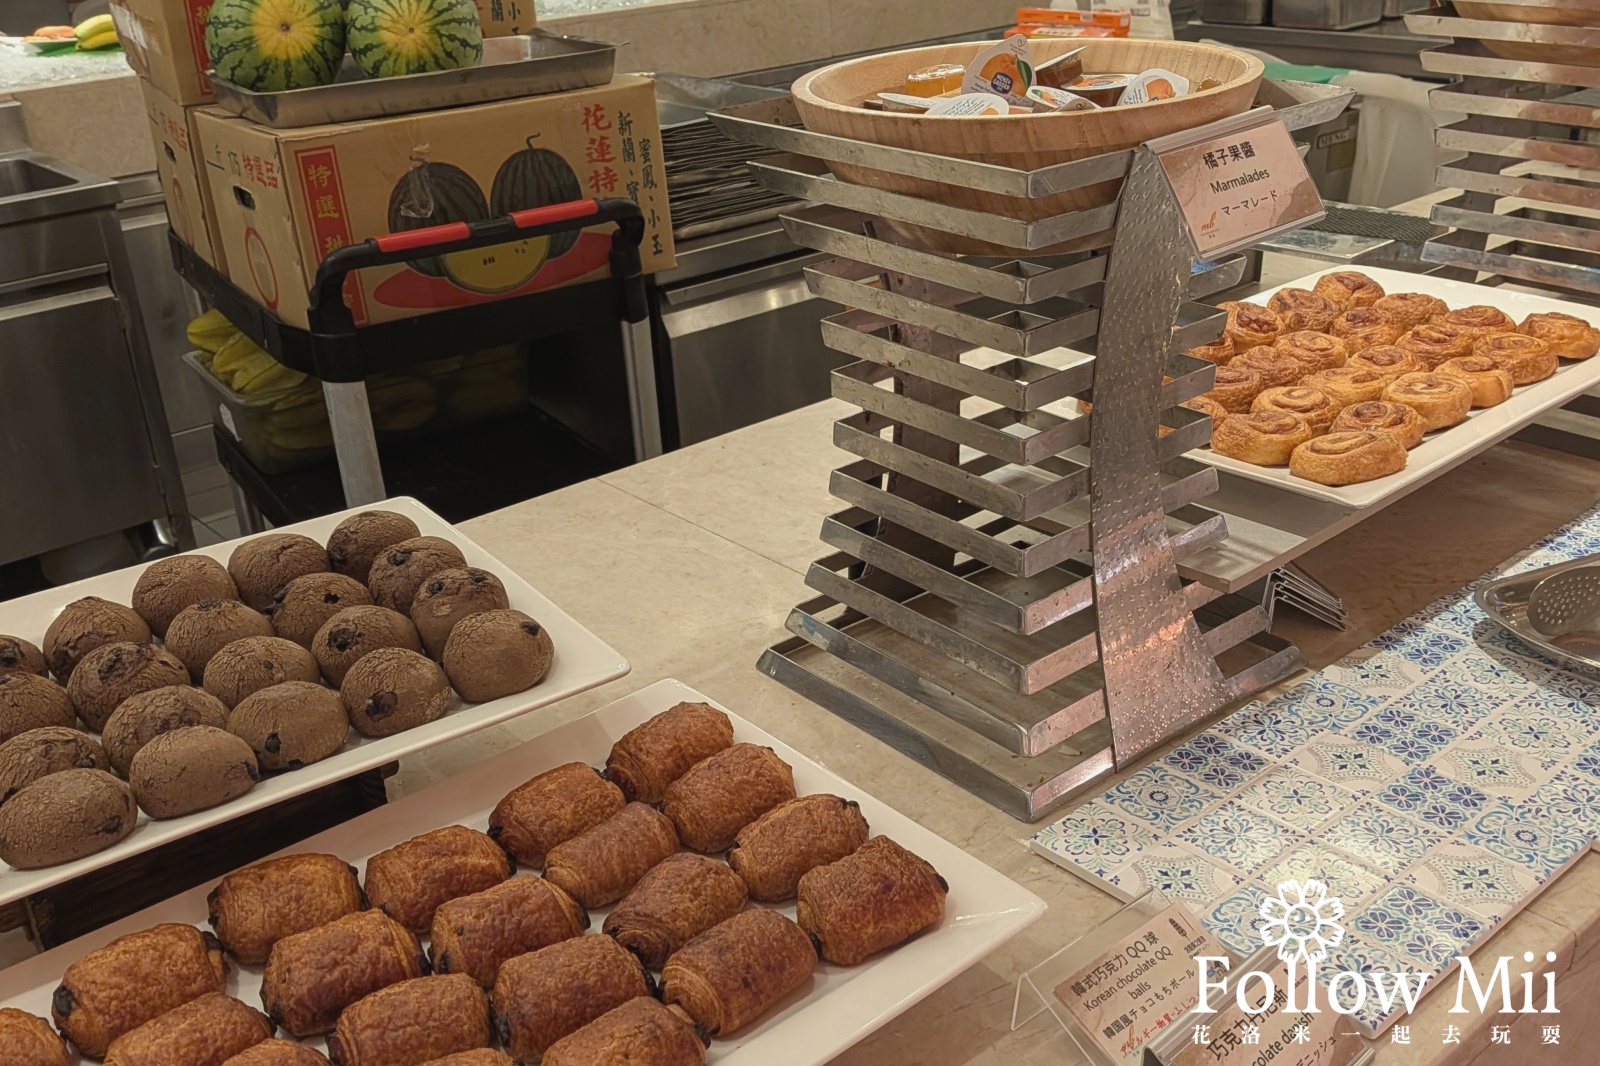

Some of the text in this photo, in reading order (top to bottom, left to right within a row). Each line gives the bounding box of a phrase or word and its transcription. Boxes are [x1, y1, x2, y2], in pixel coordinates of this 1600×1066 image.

[581, 104, 618, 200] 花蓮特
[1202, 141, 1256, 170] 橘子果醬
[1210, 168, 1270, 194] Marmalades
[1221, 189, 1278, 215] マーマレード
[1070, 930, 1160, 998] 韓式巧克力 QQ 球
[1082, 986, 1118, 1012] Korean
[1116, 957, 1158, 990] chocolate
[1154, 945, 1174, 961] QQ
[1127, 981, 1152, 1000] balls
